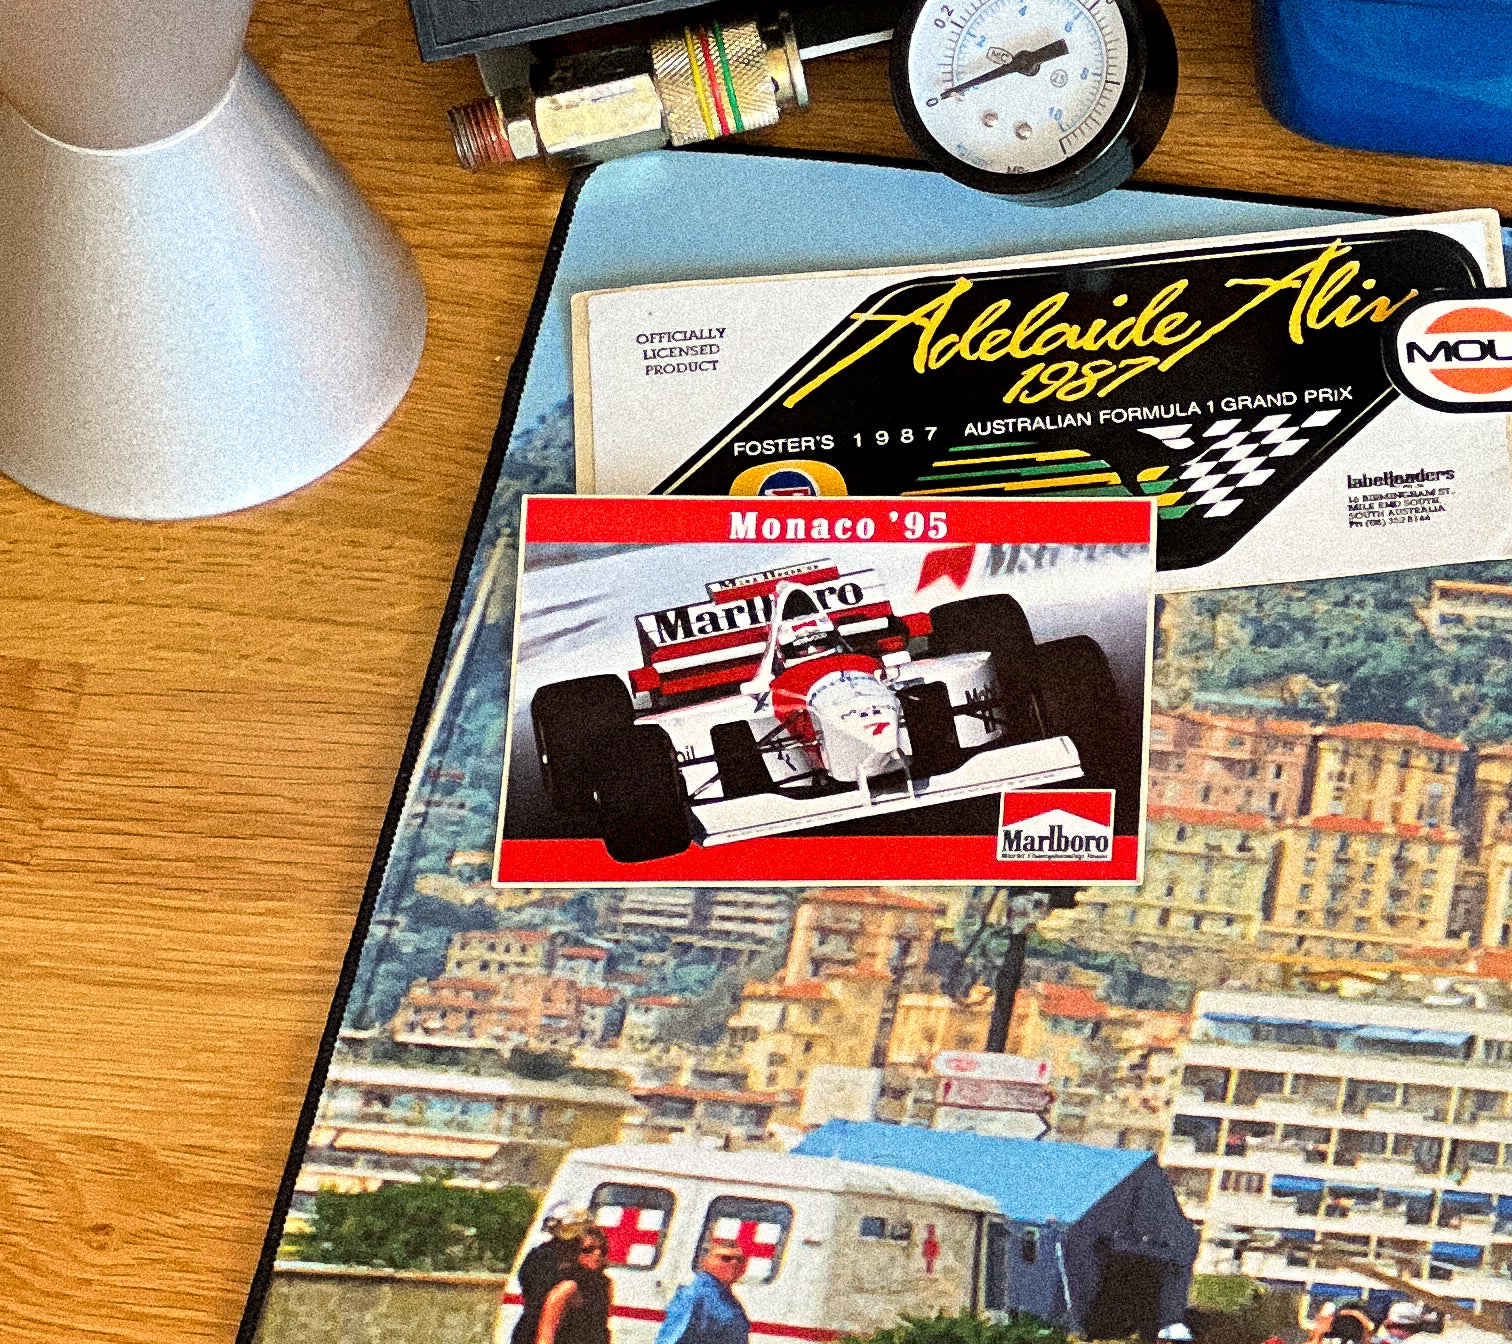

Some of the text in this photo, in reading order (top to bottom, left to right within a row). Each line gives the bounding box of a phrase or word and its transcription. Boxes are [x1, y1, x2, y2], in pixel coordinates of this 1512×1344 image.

[635, 327, 727, 345] OFFICIALLY
[783, 238, 1419, 408] Adelaide Aliv
[643, 343, 720, 360] LICENSED
[645, 359, 719, 375] PRODUCT
[1002, 356, 1162, 404] 1987
[733, 434, 834, 456] FOSTER'S
[963, 411, 1091, 437] AUSTRALIAN
[1099, 400, 1201, 423] FORMULA
[1206, 399, 1215, 414] 1
[1221, 391, 1298, 412] GRAND
[1304, 385, 1354, 404] PRIX
[729, 510, 949, 540] Monaco '95
[1348, 504, 1446, 521] SOUTH AUSTRALIA
[653, 582, 864, 645] Marlro
[864, 721, 891, 736] 7
[1001, 824, 1109, 853] Marlboro
